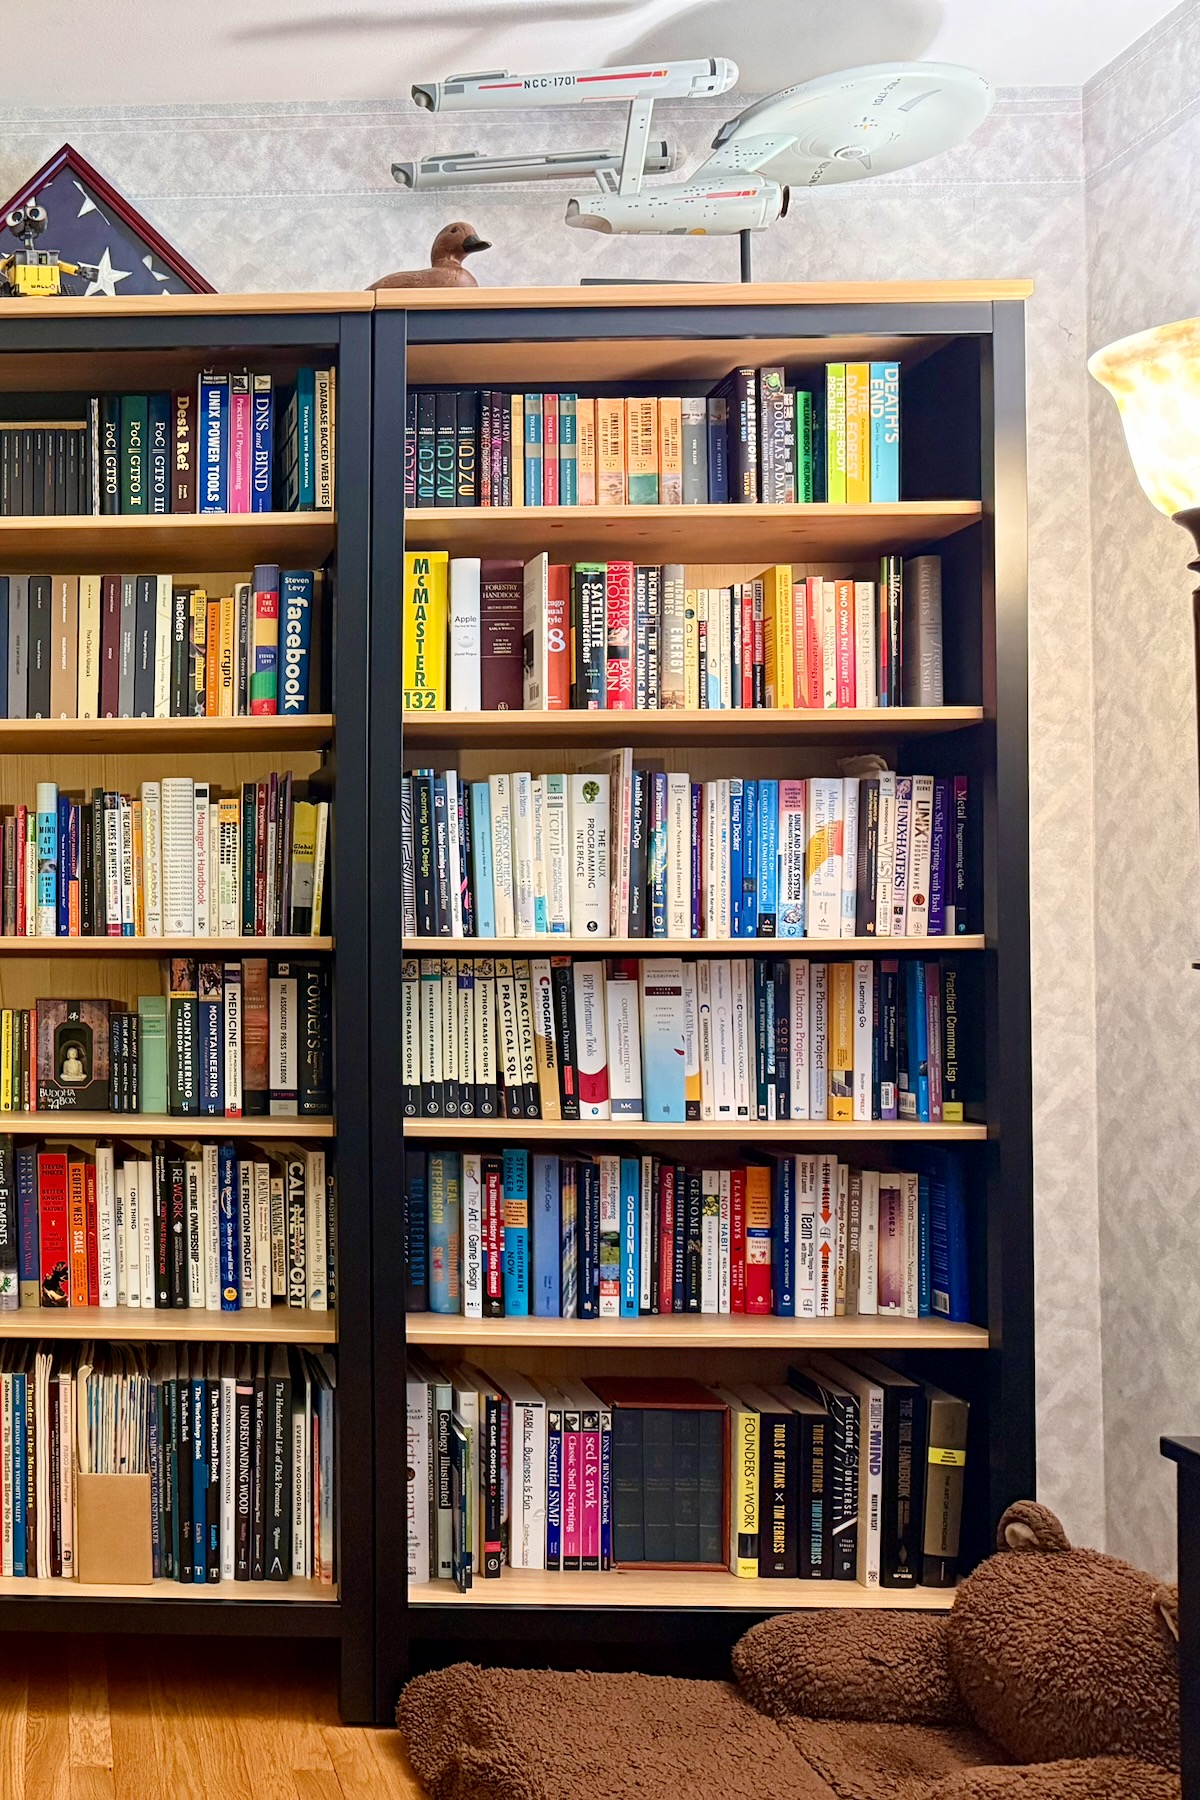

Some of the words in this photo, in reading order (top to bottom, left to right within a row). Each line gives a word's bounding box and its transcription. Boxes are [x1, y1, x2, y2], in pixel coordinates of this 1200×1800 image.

[524, 76, 575, 89] NCC-1701
[208, 390, 221, 417] UNIX
[319, 382, 329, 425] DATABASE
[747, 380, 755, 395] WE
[871, 379, 884, 418] END
[177, 396, 189, 437] Desk
[255, 398, 269, 430] DNS
[747, 397, 755, 414] ARE
[885, 368, 899, 443] DEATH'S
[207, 420, 221, 462] POWER
[255, 432, 263, 448] and
[320, 426, 329, 460] BACKED
[748, 415, 756, 462] LEGION
[177, 441, 189, 470] Ref
[255, 450, 269, 491] BIND
[320, 462, 329, 481] WEB
[207, 465, 221, 501] TOOLS
[320, 482, 330, 505] SITES
[607, 565, 619, 628] RHODES
[619, 565, 630, 628] RICHARD
[176, 597, 185, 641] hackers
[412, 559, 429, 687] McMASTER
[582, 583, 590, 663] Communications
[591, 583, 603, 647] SATELLITE
[221, 649, 232, 687] crypto
[285, 597, 306, 709] facebook
[607, 661, 618, 690] SUN
[619, 660, 629, 692] DARK
[405, 692, 436, 708] 132
[419, 787, 430, 823] Learning
[731, 799, 741, 821] Using
[196, 812, 206, 857] Manager's
[420, 825, 431, 845] Web
[598, 830, 606, 847] THE
[731, 822, 741, 851] Docker
[420, 847, 431, 877] Design
[576, 830, 585, 877] INTERFACE
[586, 819, 595, 889] PROGRAMMING
[598, 850, 606, 877] LINUX
[196, 858, 206, 905] Handbook
[813, 968, 825, 987] The
[813, 991, 825, 1031] Phoenix
[858, 981, 867, 1014] Learning
[228, 993, 237, 1047] MEDICINE
[519, 984, 532, 1051] PRACTICAL
[858, 1015, 867, 1027] Go
[209, 1005, 217, 1098] MOUNTAINEERING
[524, 1055, 533, 1078] SQL
[813, 1034, 825, 1069] Project
[243, 1167, 251, 1185] THE
[850, 1179, 859, 1195] THE
[173, 1169, 183, 1217] REWORK
[467, 1190, 478, 1205] The
[689, 1180, 699, 1235] GENOME
[243, 1187, 251, 1232] FRICTION
[468, 1207, 479, 1221] Art
[850, 1199, 859, 1223] CODE
[468, 1223, 479, 1231] of
[850, 1226, 859, 1251] BOOK
[243, 1234, 251, 1279] PROJECT
[468, 1234, 479, 1259] Game
[468, 1261, 479, 1290] Design
[584, 1437, 598, 1459] sed
[744, 1418, 756, 1477] FOUNDERS
[773, 1424, 786, 1449] TOOLS
[584, 1464, 598, 1475] &
[773, 1451, 786, 1462] OF
[745, 1479, 756, 1489] AT
[773, 1463, 786, 1488] TITANS
[584, 1479, 598, 1508] awk
[745, 1492, 757, 1528] WORK
[773, 1505, 786, 1519] TIM
[773, 1521, 786, 1553] FERRISS
